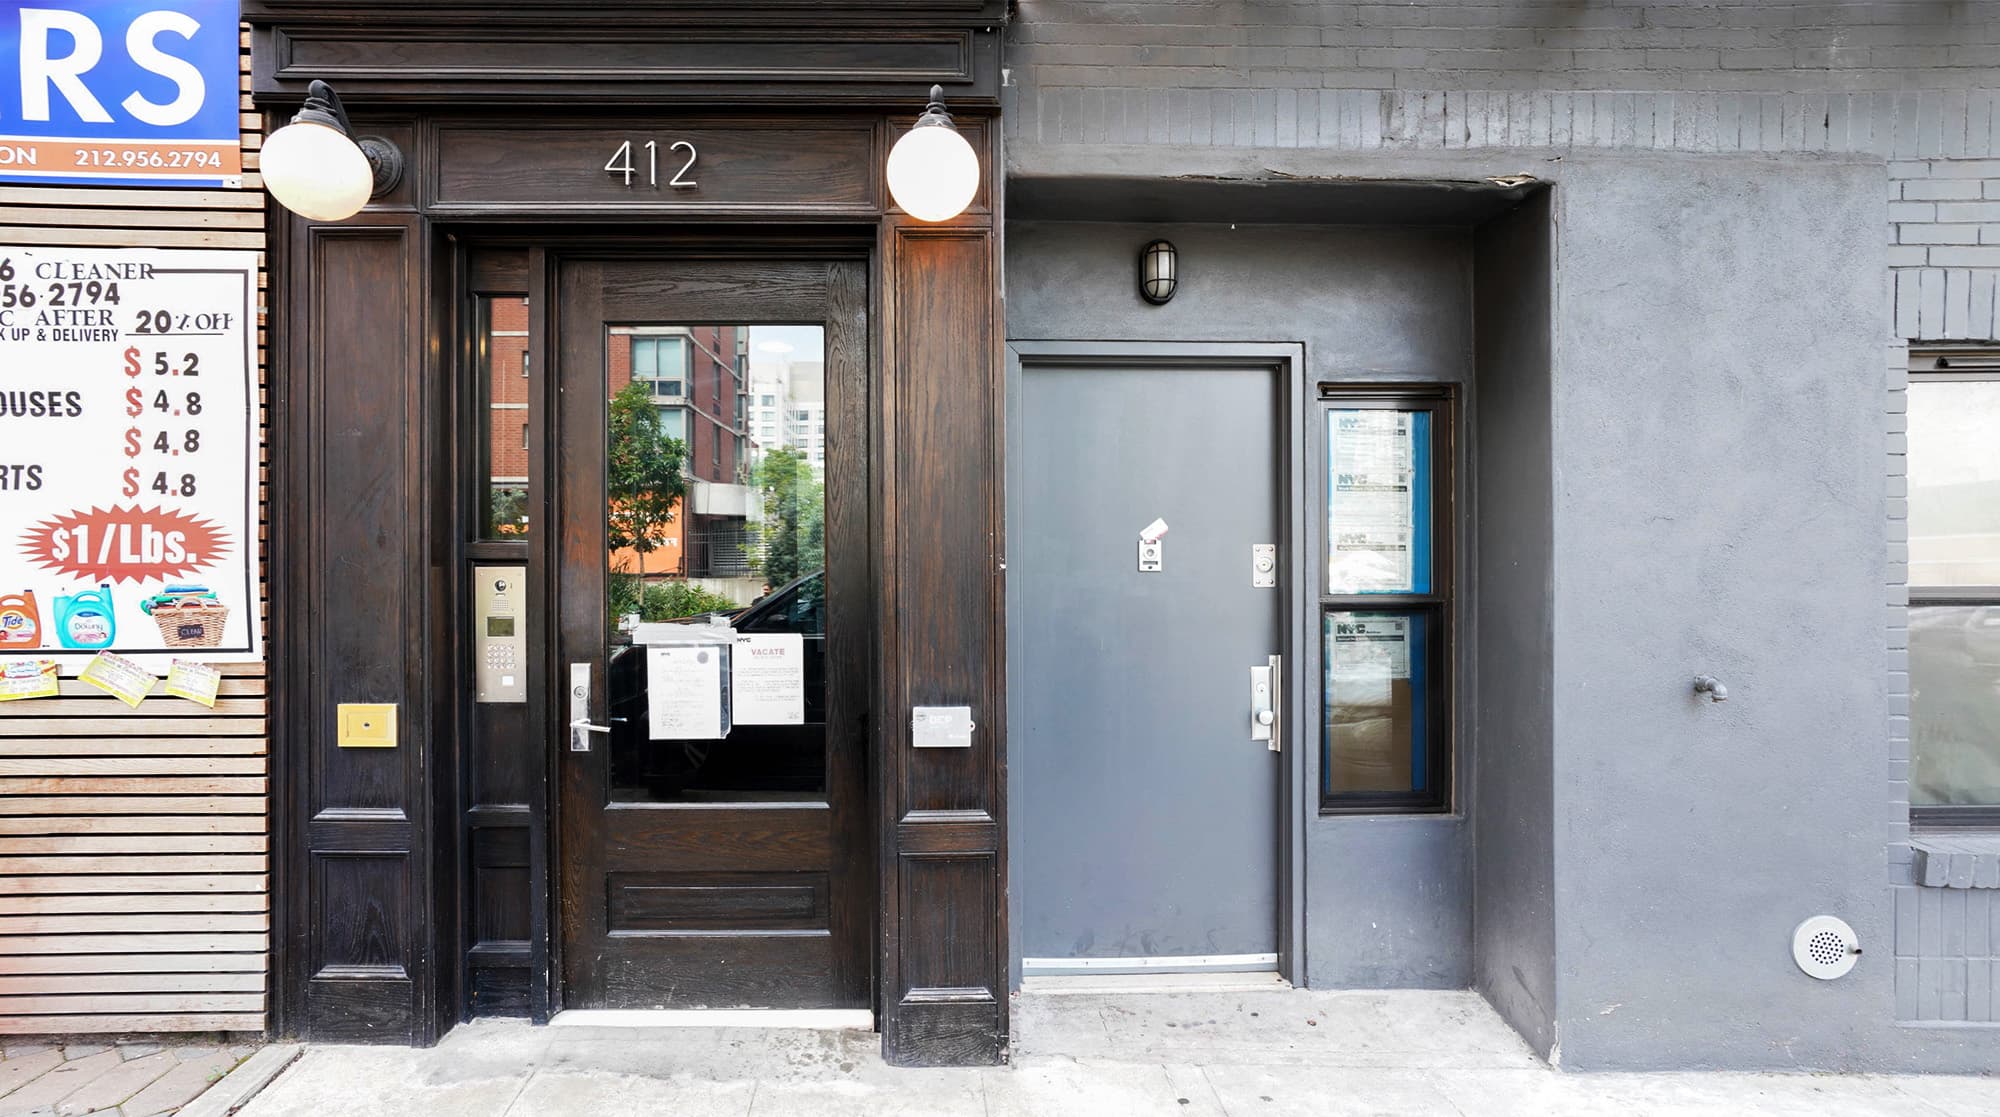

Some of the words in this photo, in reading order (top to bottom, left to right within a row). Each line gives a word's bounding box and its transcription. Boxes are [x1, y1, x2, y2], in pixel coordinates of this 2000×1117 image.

[75, 149, 222, 168] 212.956.2794
[604, 140, 699, 189] 412
[35, 262, 155, 280] CLEANER
[35, 309, 115, 327] AFTER
[11, 328, 30, 341] UP
[36, 328, 47, 341] &
[53, 328, 119, 342] DELIVERY
[153, 389, 202, 415] 4.8
[153, 429, 200, 454] 4.8
[152, 471, 197, 497] 4.8
[3, 616, 23, 628] Tide
[1337, 624, 1366, 635] NYC
[751, 648, 785, 656] VACATE
